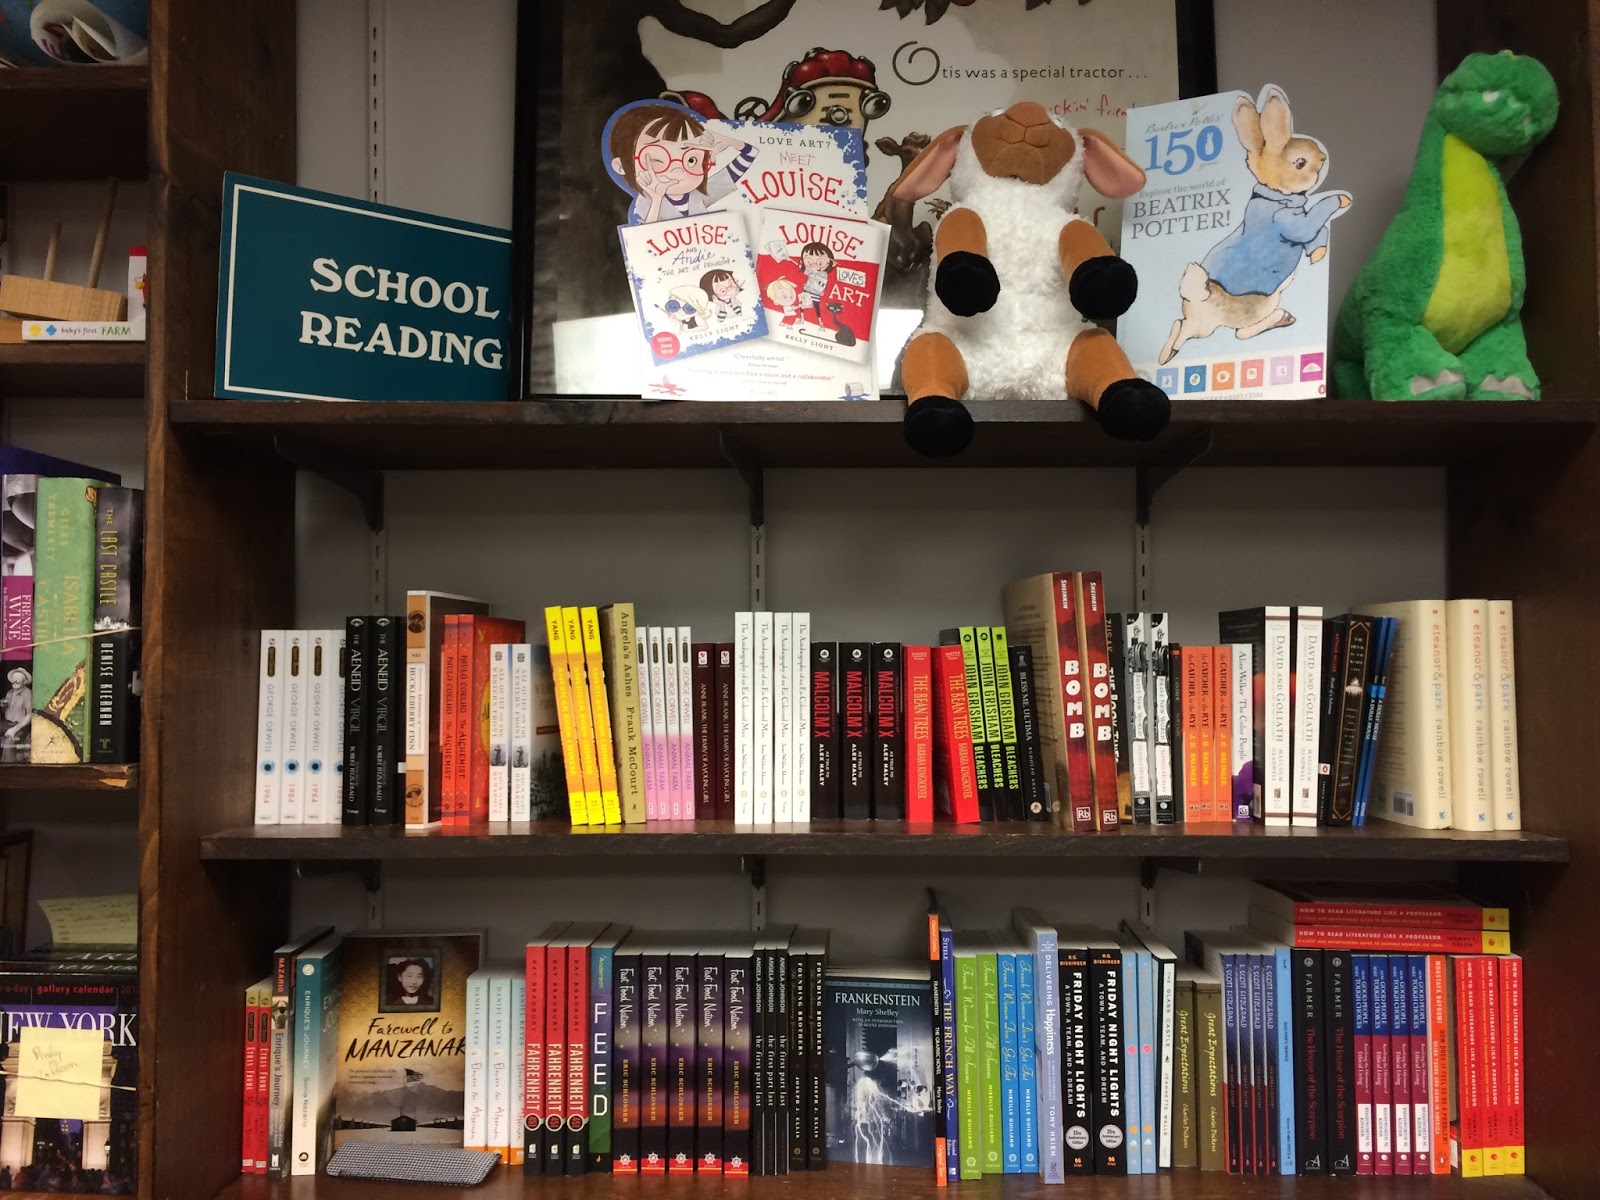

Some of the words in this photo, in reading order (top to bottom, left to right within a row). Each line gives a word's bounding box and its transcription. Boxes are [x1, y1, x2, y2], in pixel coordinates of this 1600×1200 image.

[965, 69, 996, 79] was
[1000, 69, 1007, 79] a
[1013, 65, 1065, 81] special
[759, 136, 792, 146] LOVE
[799, 137, 830, 148] ART?
[1145, 126, 1223, 175] 150
[780, 152, 815, 167] MEET
[1140, 188, 1171, 198] Explore
[1174, 184, 1188, 193] the
[1190, 180, 1214, 191] world
[1217, 178, 1226, 186] of
[1133, 188, 1231, 218] BEATRIX
[1132, 210, 1230, 239] POTTER!
[673, 249, 715, 265] Andie
[310, 257, 500, 319] SCHOOL
[838, 270, 864, 286] LOVES
[829, 284, 870, 308] ART
[61, 327, 81, 335] baby's
[102, 327, 131, 335] FARM
[299, 310, 503, 369] READING
[690, 332, 713, 341] KELLY
[716, 324, 739, 337] LIGHT
[106, 509, 114, 526] THE
[100, 530, 118, 556] LAST
[99, 564, 117, 605] CASTLE
[1060, 579, 1069, 609] SHEINKIN
[8, 594, 21, 641] WINE
[21, 594, 31, 641] FRENCH
[551, 620, 560, 641] YANG
[620, 612, 633, 660] Angela's
[1432, 624, 1442, 671] eleanor
[100, 643, 113, 677] DENISE
[1276, 635, 1286, 670] DAVID
[446, 656, 454, 681] PAULO
[623, 664, 633, 697] Ashes
[682, 667, 690, 695] GEORGE
[964, 664, 977, 689] JOHN
[1432, 672, 1443, 681] &
[913, 675, 928, 691] THE
[1238, 671, 1246, 695] Walker
[99, 684, 113, 726] KIERNAN
[266, 684, 274, 720] GEORGE
[878, 671, 893, 727] MALCOLM
[913, 693, 928, 714] BEAN
[1064, 660, 1085, 739] BOMB
[1239, 699, 1247, 714] The
[1432, 683, 1443, 711] park
[626, 707, 635, 741] Frank
[914, 715, 928, 739] TREES
[967, 692, 983, 740] GRISHAM
[1239, 715, 1247, 735] Color
[1276, 693, 1286, 742] GOLIATH
[265, 721, 273, 753] ORWELL
[408, 730, 416, 750] FINN
[878, 730, 894, 738] X
[1435, 719, 1445, 762] rainbow
[444, 734, 453, 780] ALCHEMIST
[684, 743, 692, 769] ANIMAL
[916, 743, 926, 766] BARBARA
[1238, 737, 1247, 760] Purple
[628, 746, 638, 795] McCourt
[974, 746, 987, 789] BLEACHERS
[917, 767, 927, 799] KINGSOLVER
[1437, 766, 1446, 799] rowell
[941, 937, 950, 961] STEELE
[277, 957, 285, 993] NAZARIO
[619, 968, 634, 983] Fast
[1045, 954, 1053, 1006] DELIVERING
[36, 985, 71, 995] gallery
[73, 984, 114, 994] calendar
[620, 986, 634, 1002] Food
[835, 992, 920, 1006] FRANKENSTEIN
[1073, 972, 1083, 1020] FRIDAY
[303, 990, 312, 1031] ENRIQUE'S
[619, 1005, 633, 1029] Nation
[857, 1008, 873, 1016] Mary
[875, 1009, 899, 1017] Shelley
[943, 1001, 953, 1022] THE
[1176, 1010, 1189, 1035] Great
[368, 1017, 437, 1036] Farewell
[442, 1021, 454, 1035] to
[1043, 1008, 1056, 1055] Happiness
[1307, 1027, 1316, 1043] The
[273, 1032, 285, 1072] Enrique's
[344, 1036, 466, 1062] MANZANAR
[755, 1035, 763, 1048] the
[943, 1026, 954, 1069] FRENCH
[1074, 1024, 1084, 1067] NIGHT
[246, 1046, 255, 1067] ETHAN
[593, 1002, 608, 1117] FEED
[755, 1051, 763, 1069] first
[1176, 1036, 1190, 1094] Expectations
[1307, 1045, 1316, 1072] House
[245, 1070, 255, 1091] FROME
[272, 1073, 283, 1106] Journey
[526, 1043, 541, 1111] FAHRENHEIT
[754, 1072, 762, 1089] part
[945, 1073, 955, 1097] WAY
[1308, 1074, 1316, 1083] of
[755, 1091, 763, 1107] last
[1076, 1070, 1086, 1118] LIGHTS
[1308, 1085, 1316, 1099] the
[301, 1100, 309, 1128] Nazario
[528, 1115, 537, 1128] 451
[1048, 1105, 1056, 1127] TONY
[1181, 1103, 1189, 1125] Charles
[1306, 1101, 1317, 1140] Scorpion
[1049, 1128, 1057, 1157] HSIEH
[1181, 1125, 1190, 1149] Dickens
